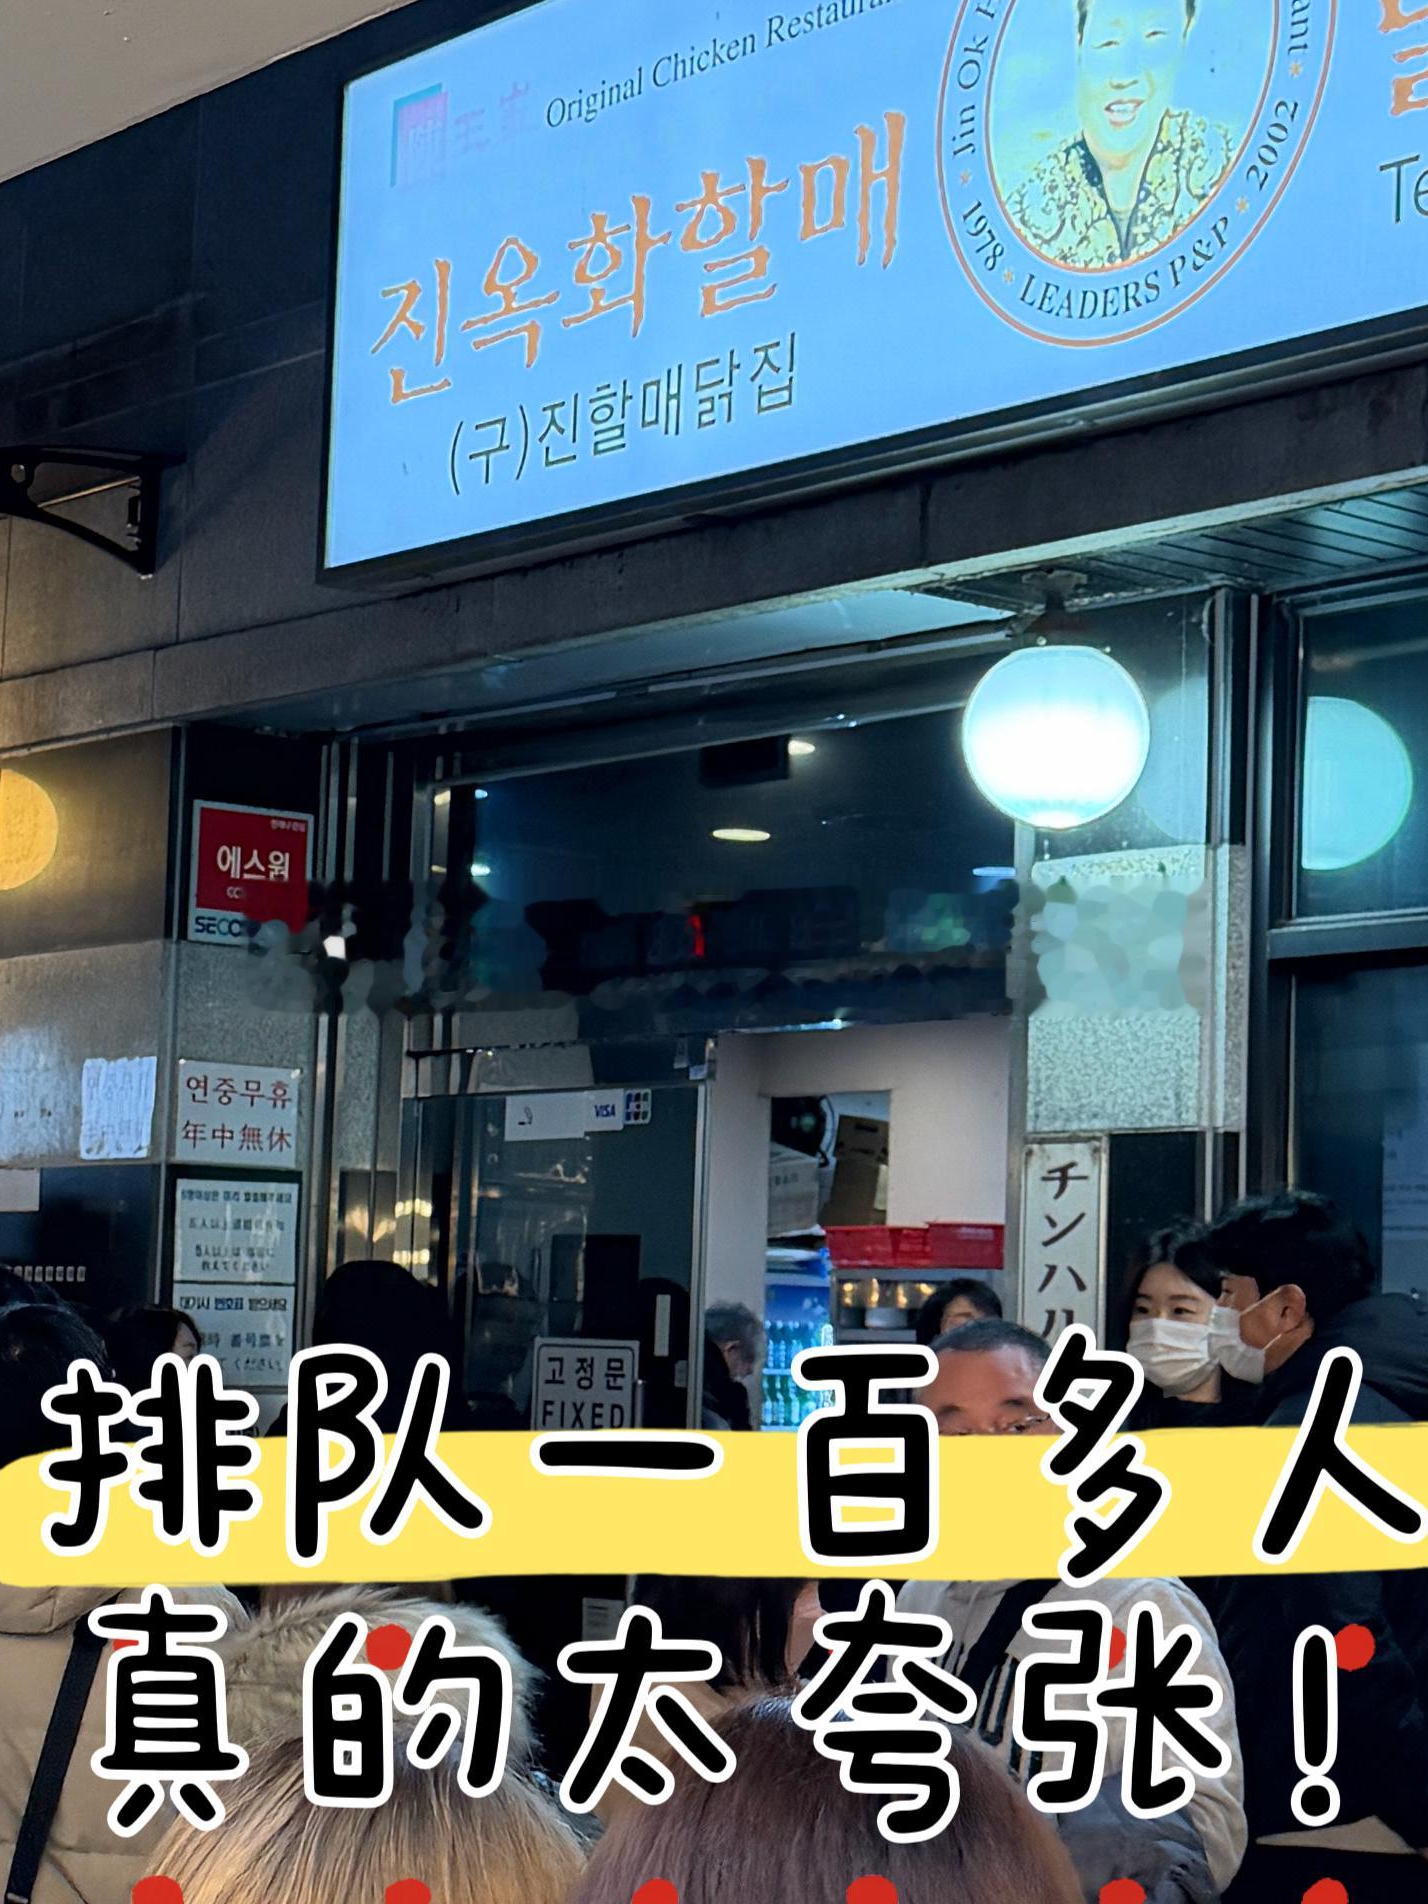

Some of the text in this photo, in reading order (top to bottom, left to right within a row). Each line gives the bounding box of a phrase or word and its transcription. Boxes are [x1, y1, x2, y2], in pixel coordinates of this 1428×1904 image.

[546, 65, 644, 129] Original
[651, 29, 757, 89] Chicken
[956, 33, 990, 89] Ok
[952, 96, 976, 159] Jin
[1245, 97, 1300, 193] 2002
[370, 110, 908, 405] 진옥화할매
[960, 198, 1005, 273] 1978
[1019, 214, 1232, 321] LEADERS P&P
[448, 330, 799, 497] (구)진할매닭집
[216, 844, 290, 882] 에스원
[194, 915, 262, 938] SECO
[186, 1074, 292, 1110] 연중무휴
[594, 1104, 616, 1118] VISA
[182, 1119, 292, 1153] 年中無休
[544, 1356, 626, 1391] 고정문
[542, 1400, 625, 1429] FIXED
